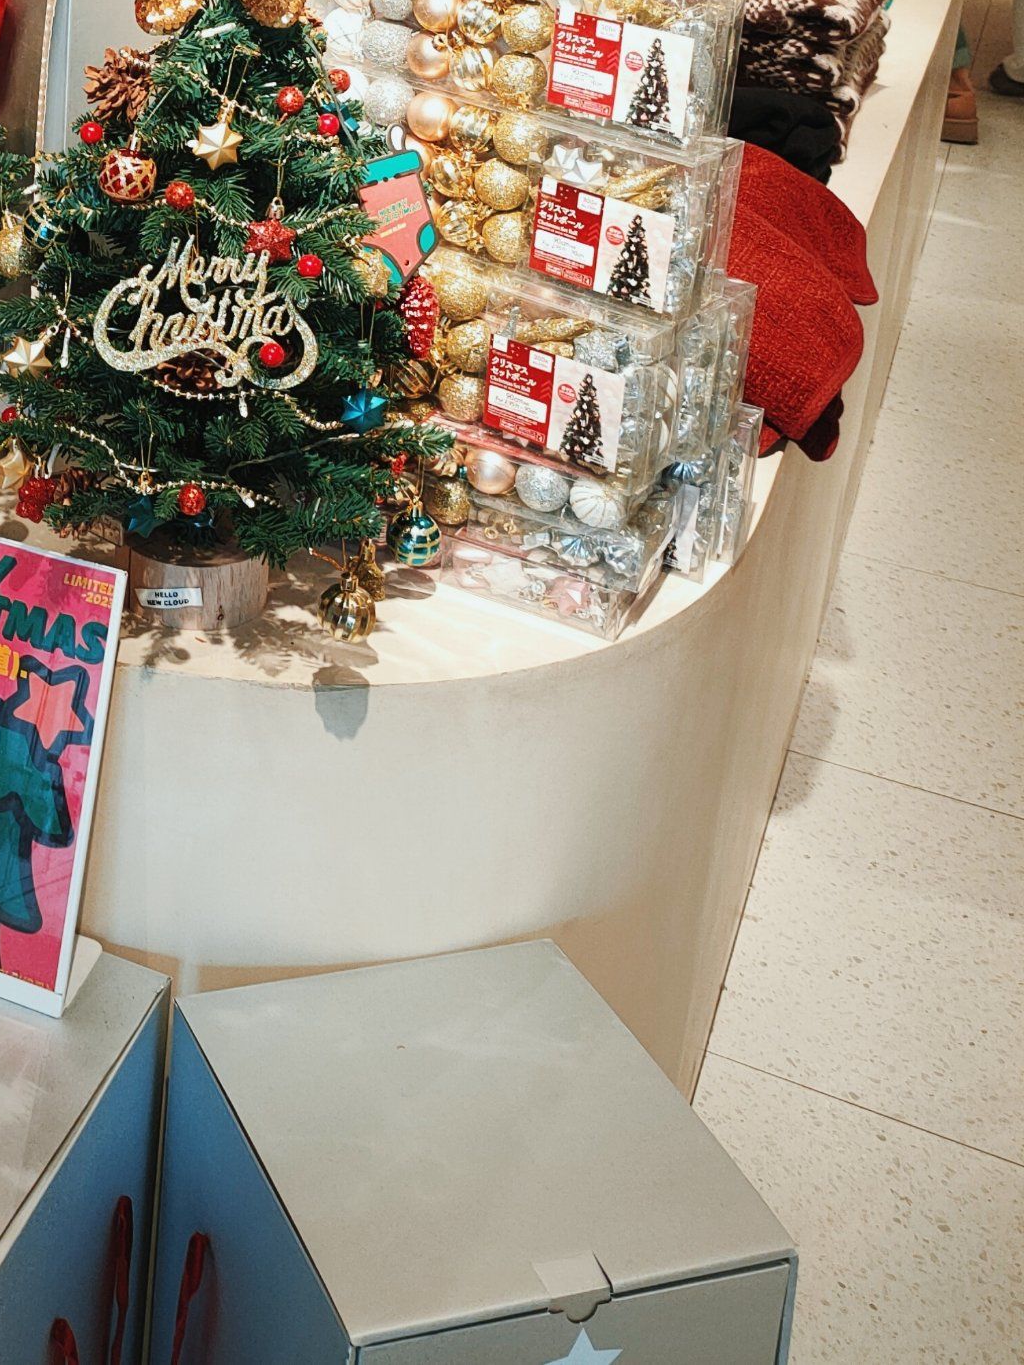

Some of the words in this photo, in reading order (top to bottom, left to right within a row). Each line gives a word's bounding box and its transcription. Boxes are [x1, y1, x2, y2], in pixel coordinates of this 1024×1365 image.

[556, 30, 596, 47] クリスマス
[539, 200, 576, 218] クリスマス
[538, 210, 584, 230] セットボール
[138, 234, 271, 306] Merry
[491, 355, 529, 376] クリスマス
[489, 365, 537, 387] セットボール
[63, 573, 114, 596] LIMITED
[163, 598, 190, 606] CLOUD
